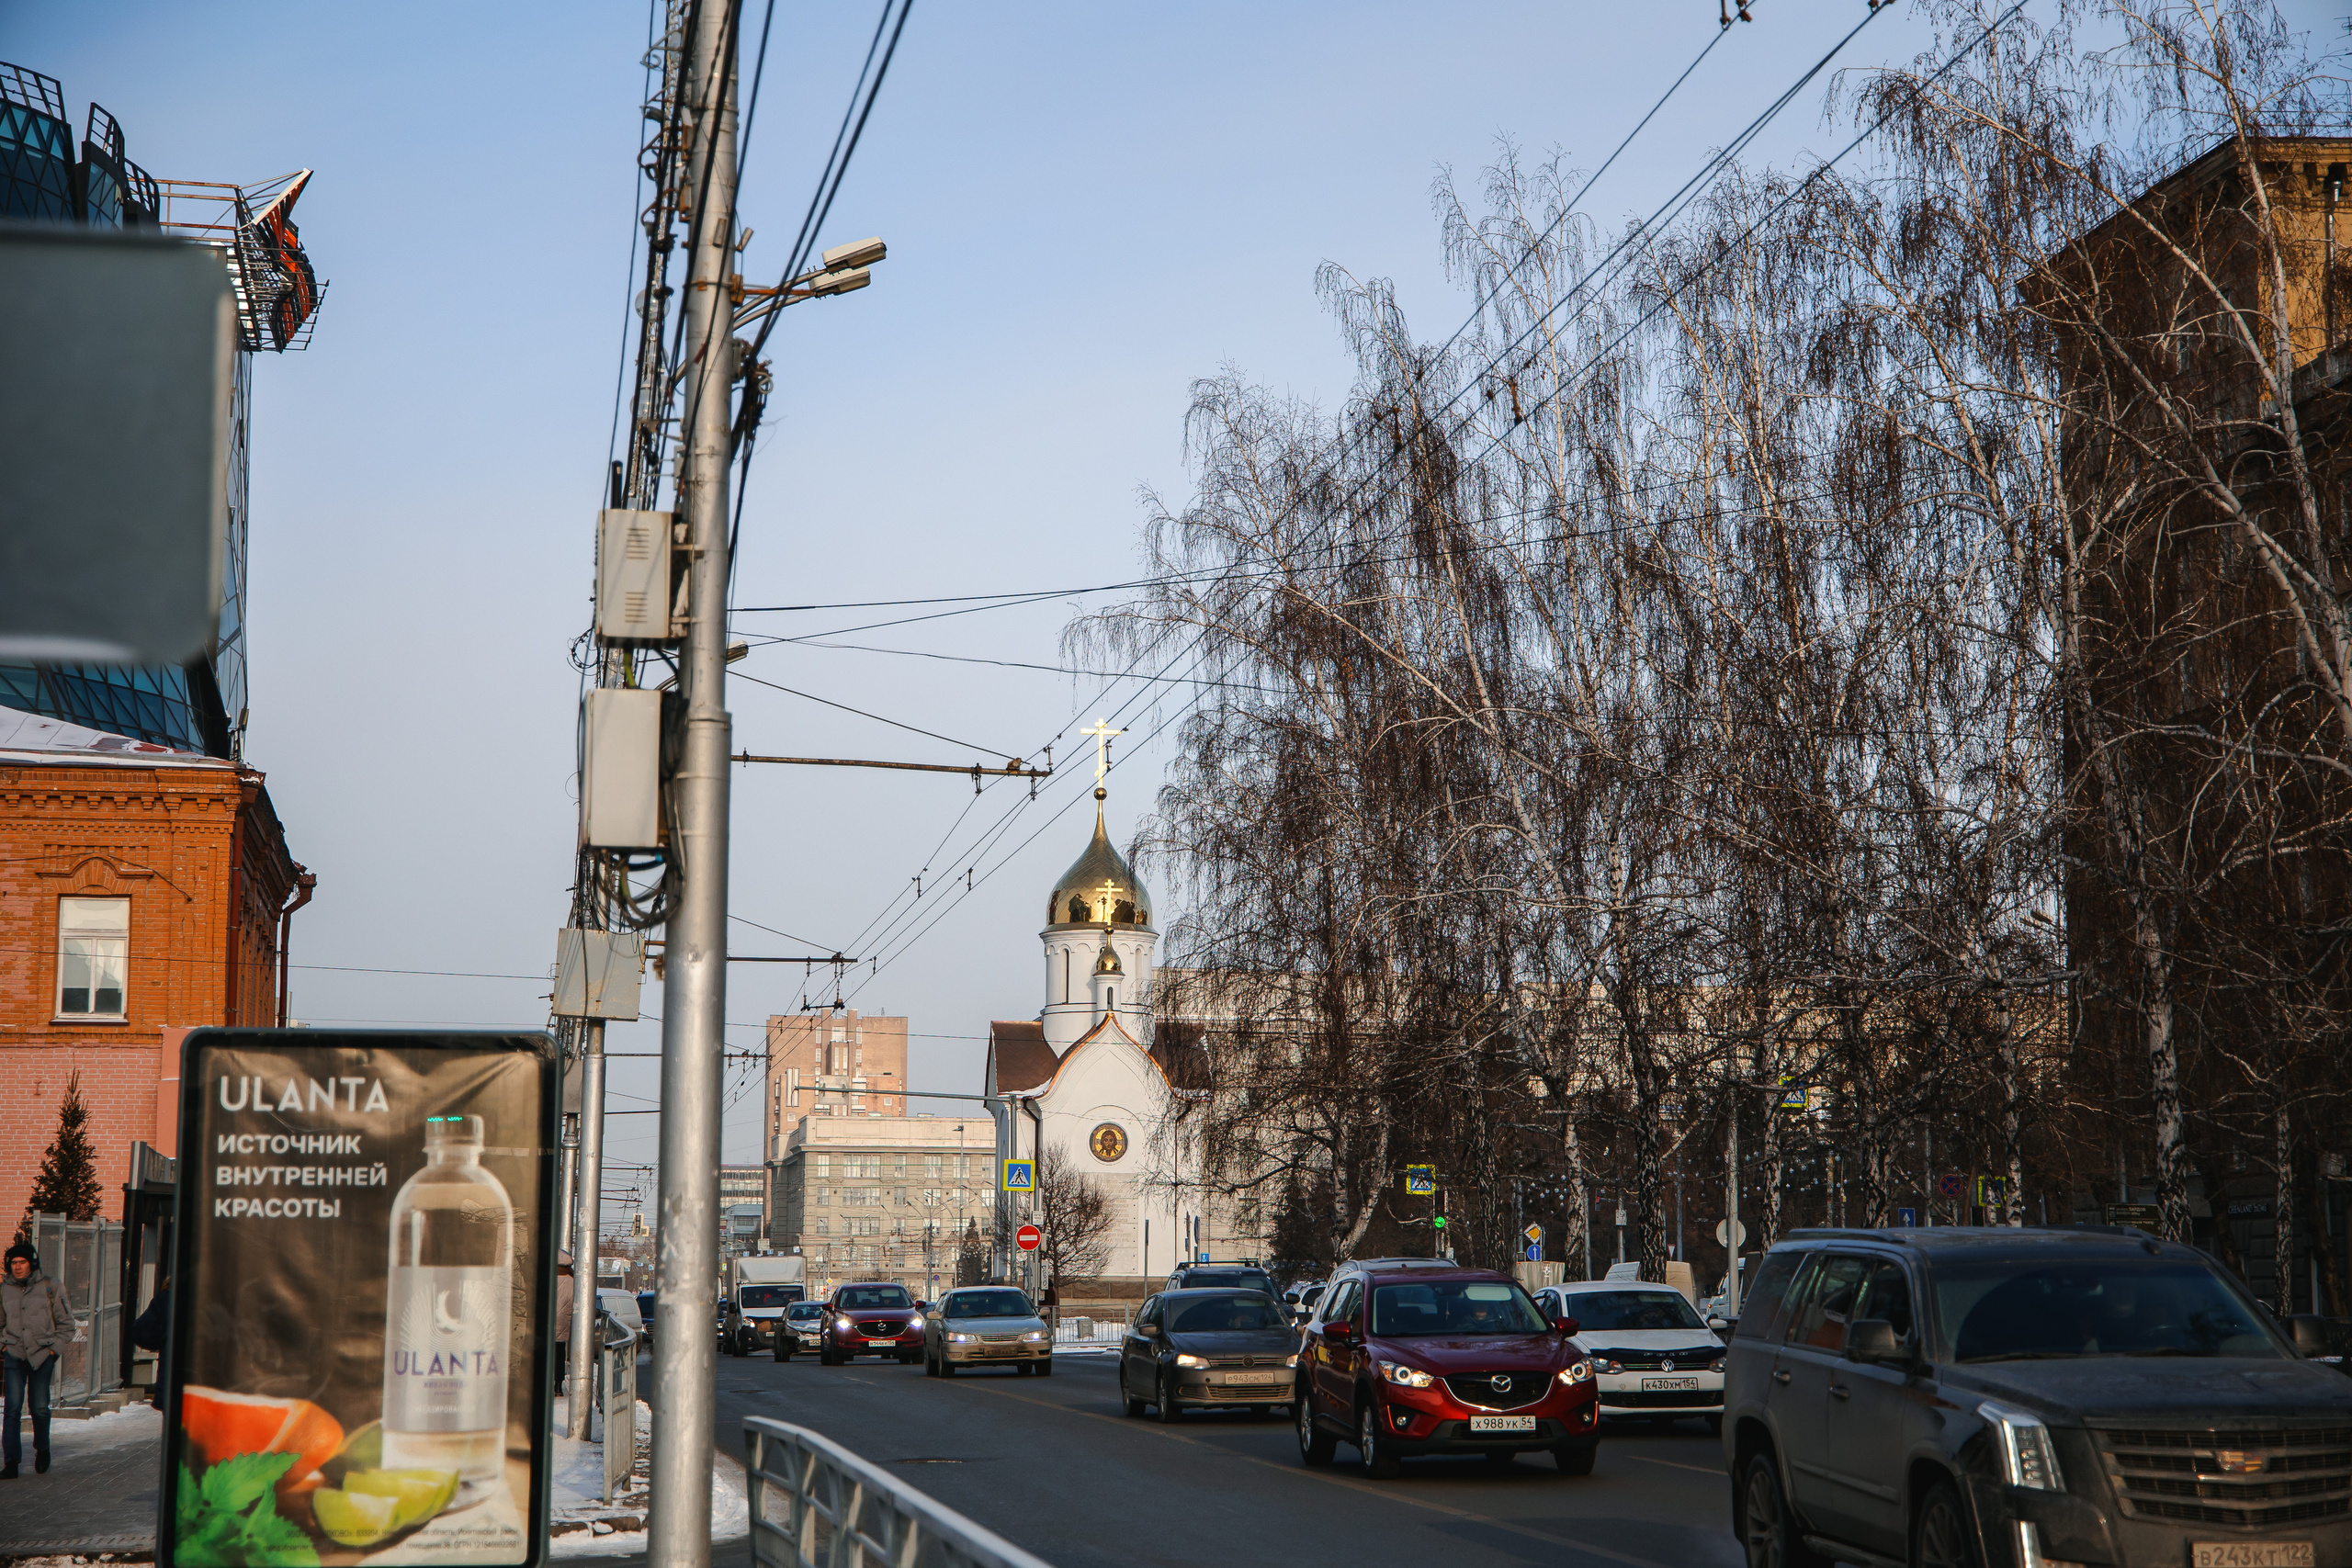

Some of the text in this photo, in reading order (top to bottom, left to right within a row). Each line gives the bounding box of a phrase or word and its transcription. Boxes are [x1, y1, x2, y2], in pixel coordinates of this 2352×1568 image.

[220, 1076, 390, 1112] ULANTA
[218, 1134, 362, 1154] ИСТОЧНИК
[216, 1162, 387, 1186] ВНУТРЕННЕЙ
[214, 1198, 341, 1218] КРАСОТЫ
[393, 1350, 499, 1376] ULANTA
[1682, 1379, 1696, 1388] 154
[1521, 1416, 1532, 1426] 54
[2199, 1544, 2311, 1566] В243КТ 122
